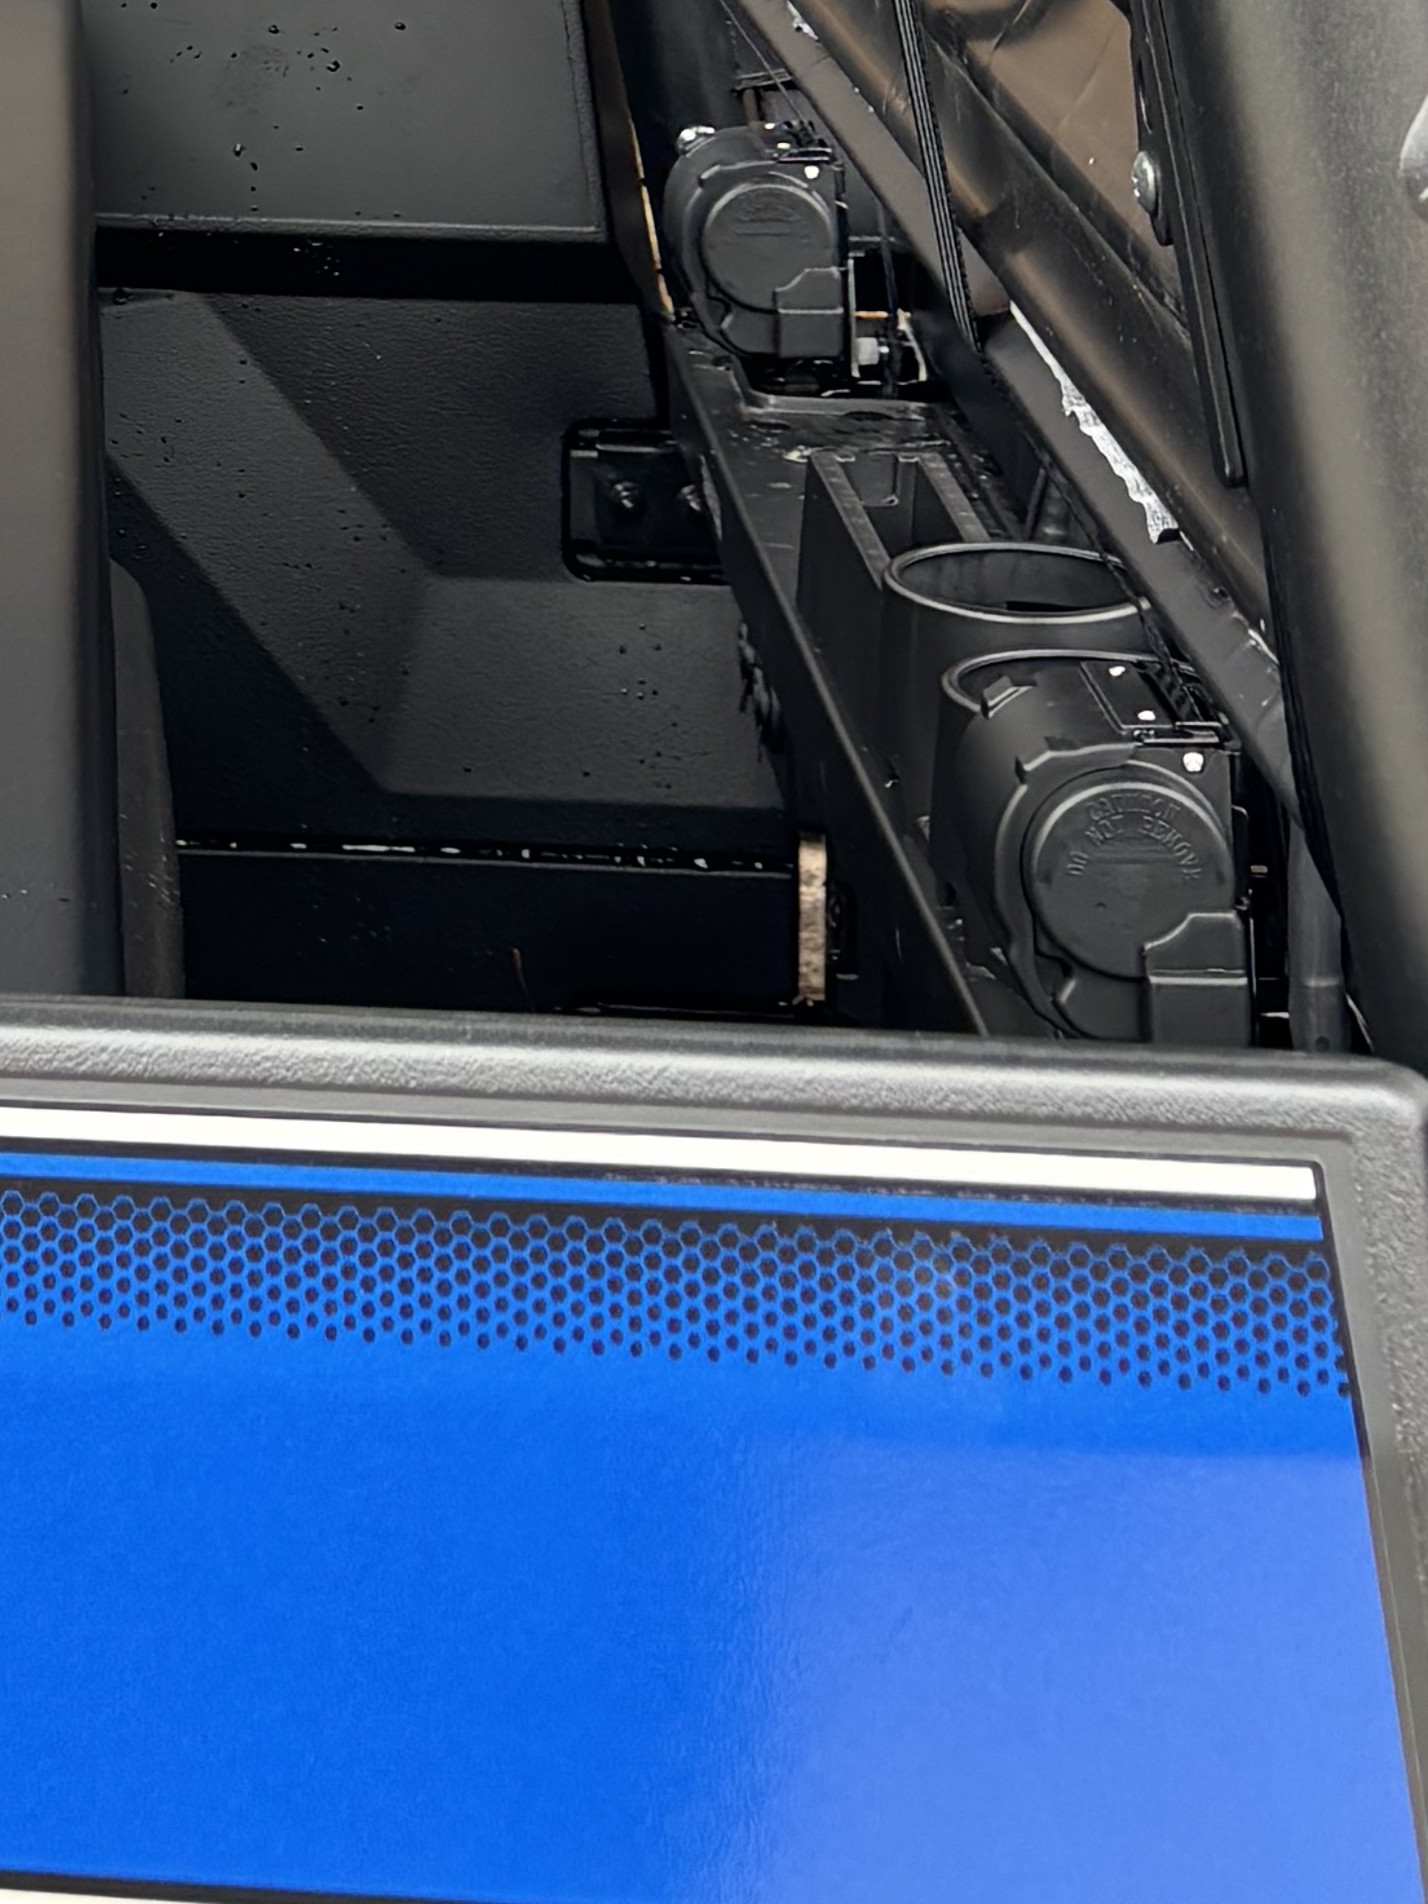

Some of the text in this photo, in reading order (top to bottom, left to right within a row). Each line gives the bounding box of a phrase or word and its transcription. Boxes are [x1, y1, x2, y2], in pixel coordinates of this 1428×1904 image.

[1084, 791, 1182, 821] CAUTION
[1066, 815, 1203, 881] DO NOT REMOVE
